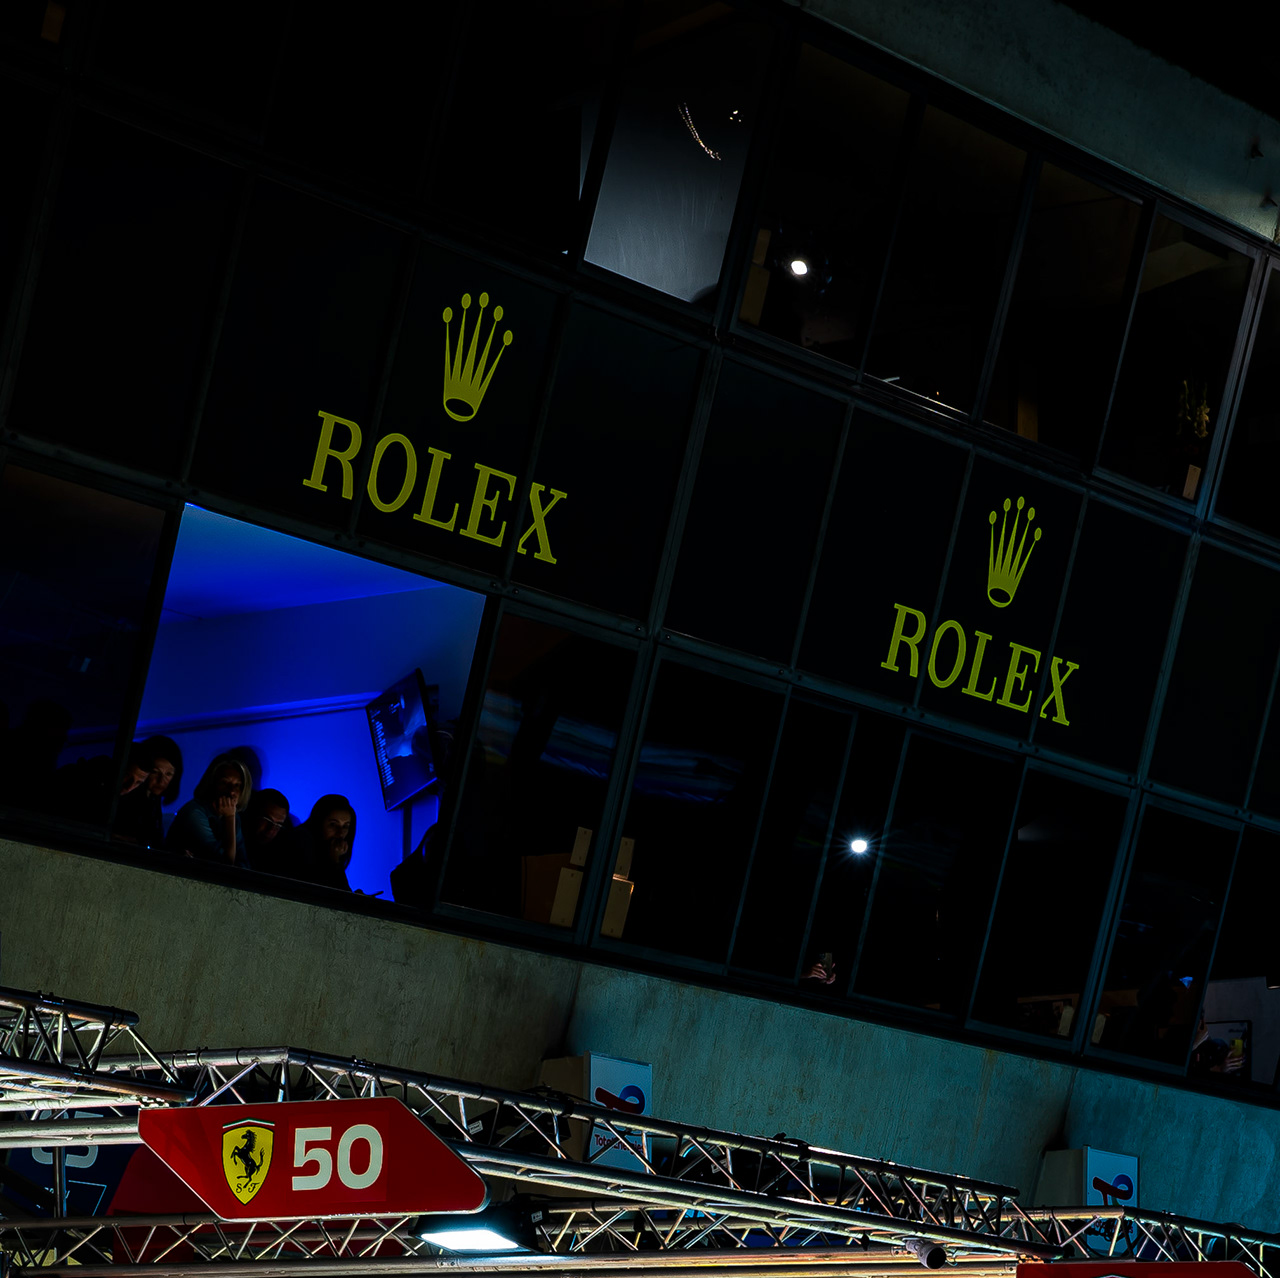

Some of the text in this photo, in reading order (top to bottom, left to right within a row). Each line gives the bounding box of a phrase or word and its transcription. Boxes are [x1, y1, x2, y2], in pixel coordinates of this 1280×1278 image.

[303, 410, 567, 564] ROLEX
[881, 603, 1079, 726] ROLEX
[292, 1124, 383, 1190] 50
